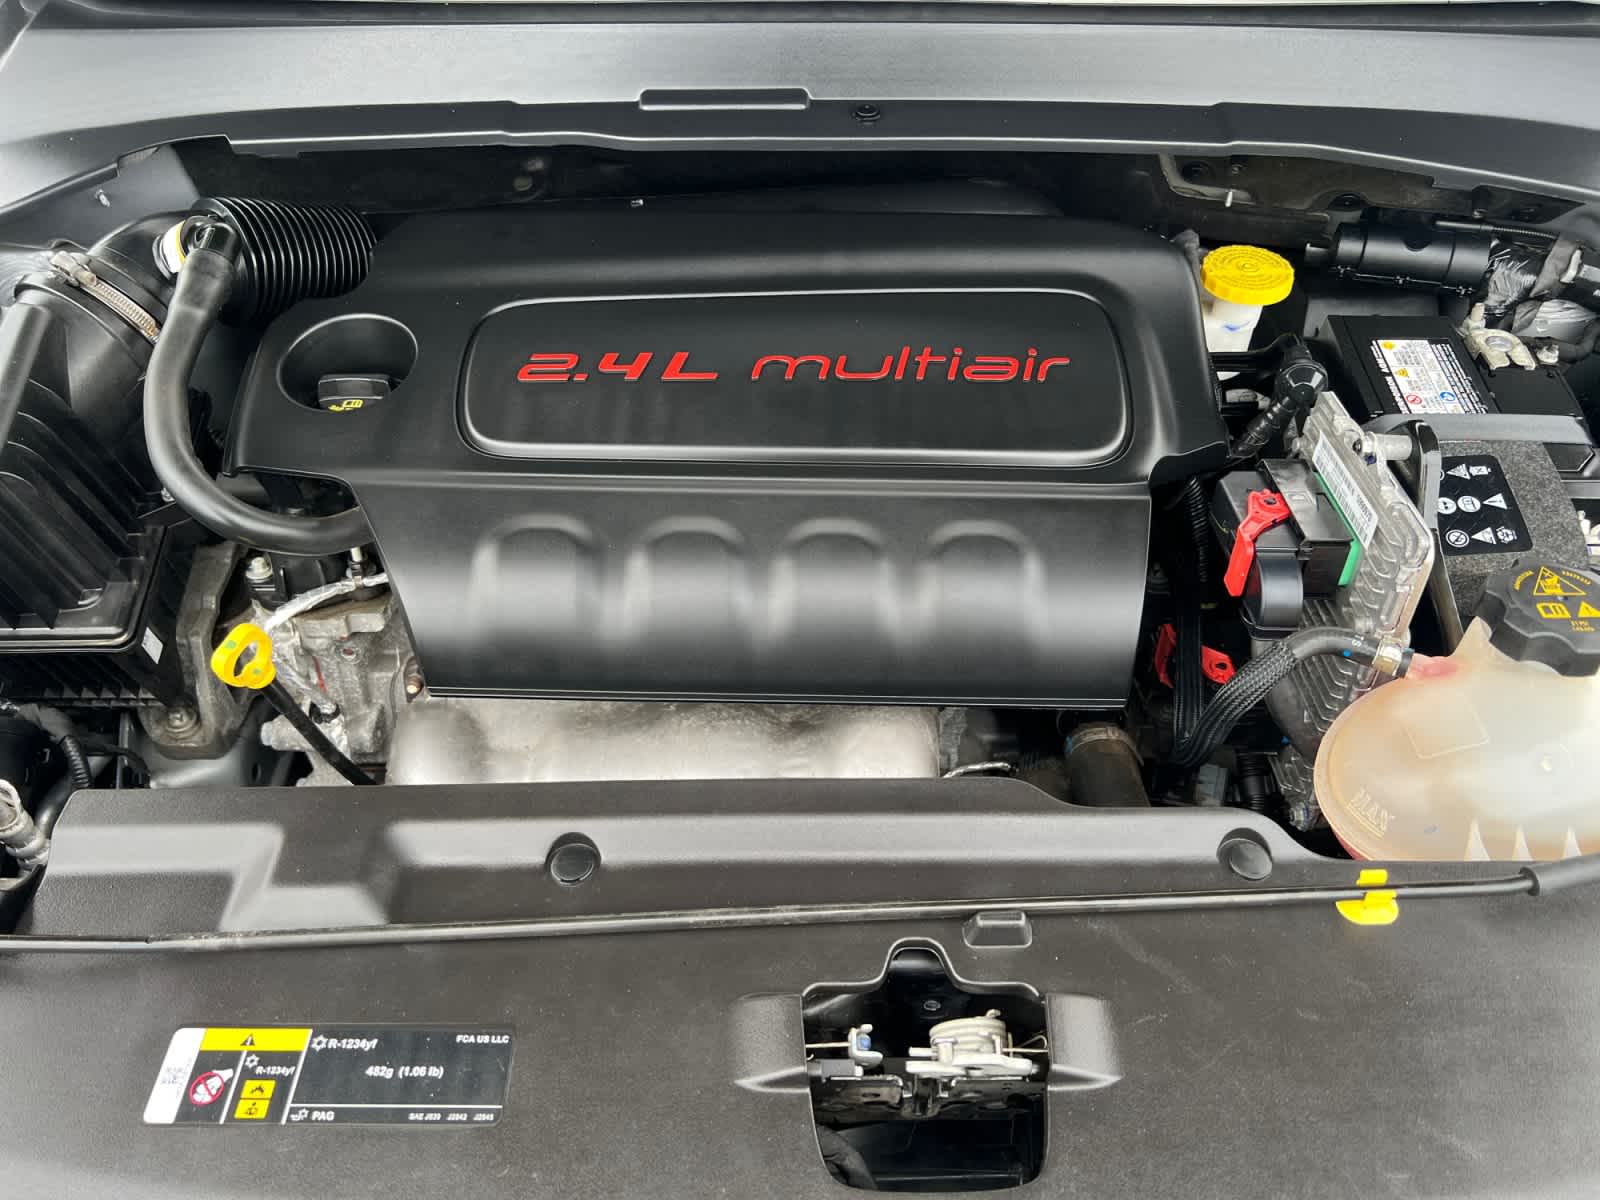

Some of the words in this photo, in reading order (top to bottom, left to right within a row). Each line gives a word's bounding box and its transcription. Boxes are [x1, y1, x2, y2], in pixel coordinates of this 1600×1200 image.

[751, 346, 1070, 383] multiair
[327, 1038, 378, 1051] R-1234yf
[456, 1034, 475, 1043] FCA
[477, 1035, 489, 1043] US
[491, 1035, 510, 1044] LLC
[255, 1066, 295, 1077] R-1234yf
[311, 1110, 335, 1121] PAG
